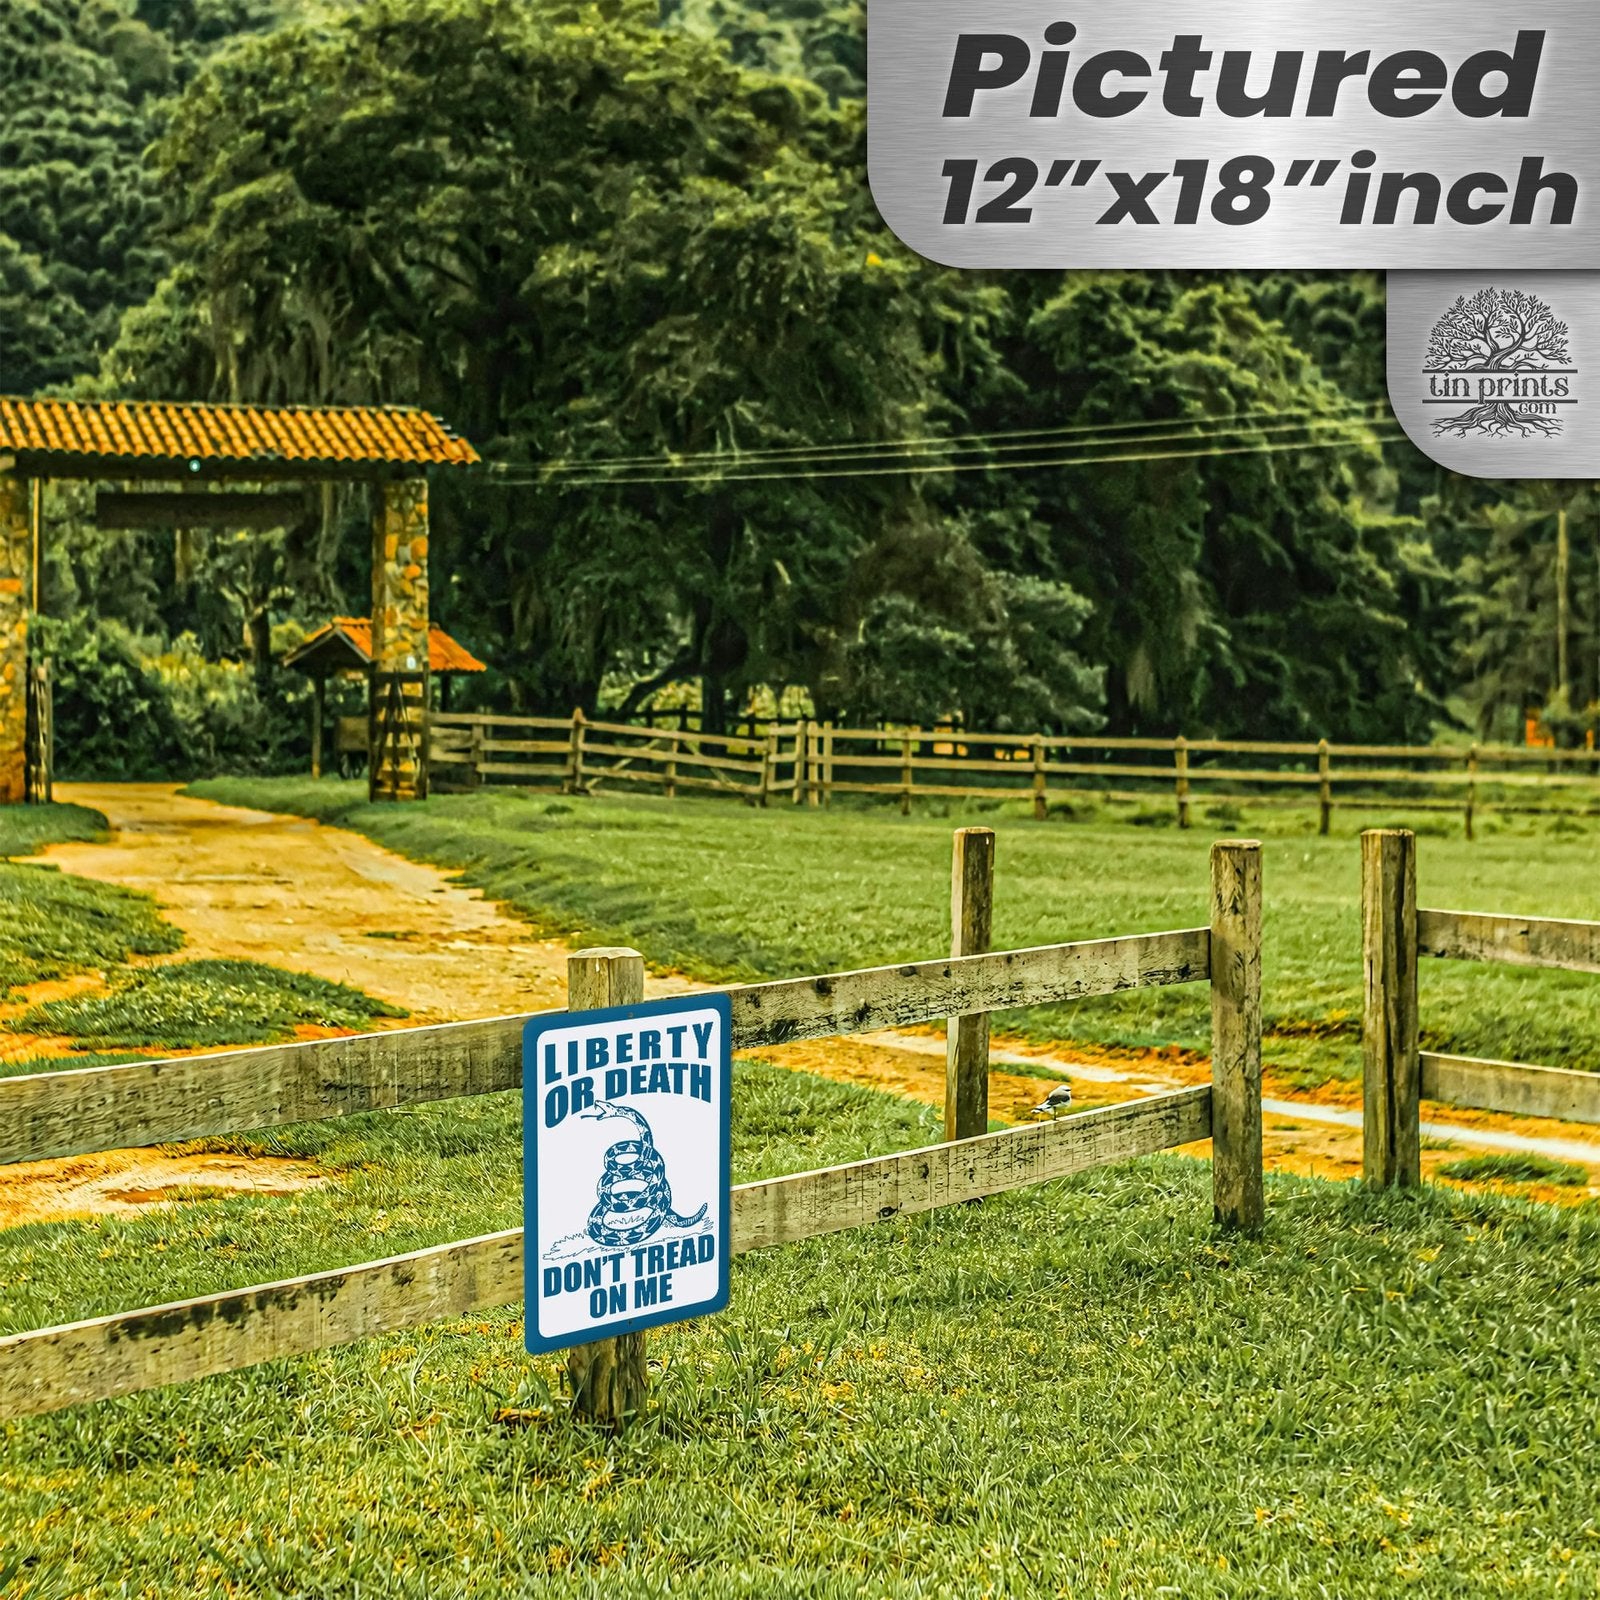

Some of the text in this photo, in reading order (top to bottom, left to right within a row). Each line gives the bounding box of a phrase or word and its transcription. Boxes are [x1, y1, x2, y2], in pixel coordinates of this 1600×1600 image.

[544, 1021, 714, 1085] LIBERTY
[544, 1062, 711, 1128] OR DEATH
[543, 1234, 715, 1298] DON'T TREAD
[589, 1273, 673, 1318] ON ME
